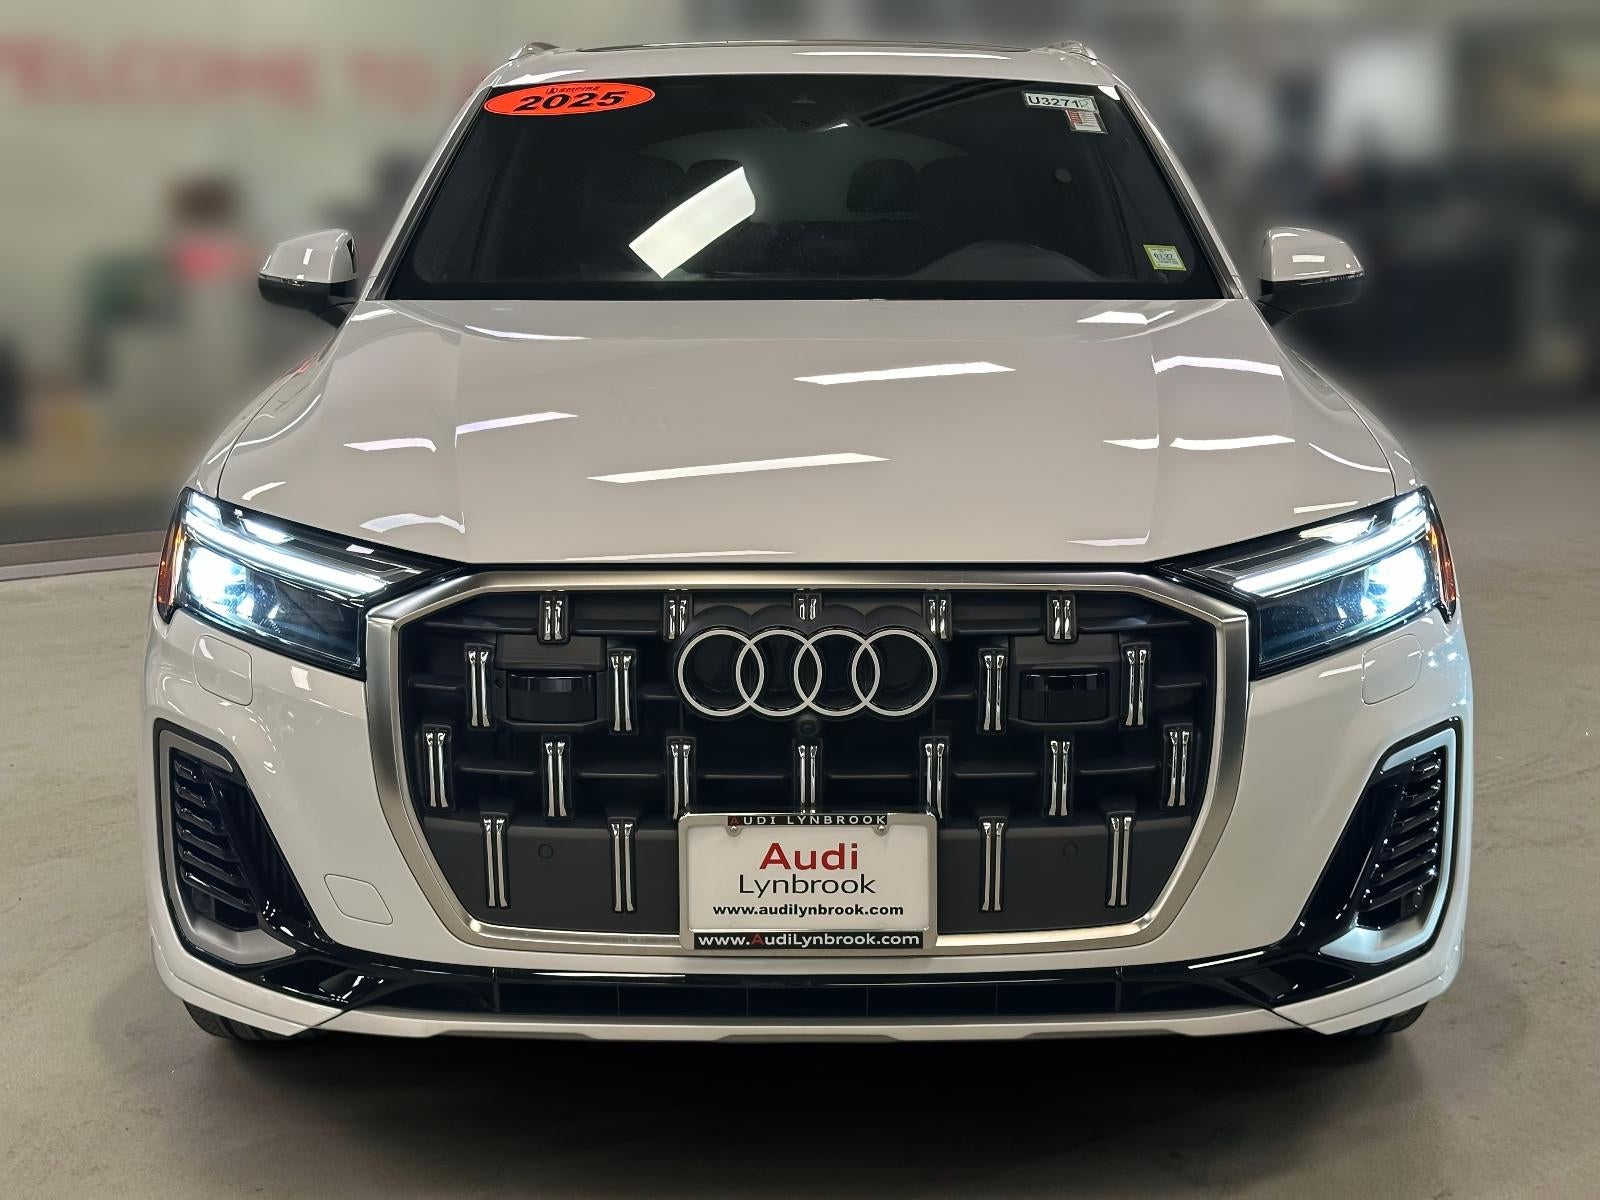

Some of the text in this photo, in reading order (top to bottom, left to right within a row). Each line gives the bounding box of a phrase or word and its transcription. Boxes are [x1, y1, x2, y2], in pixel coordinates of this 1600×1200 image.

[513, 91, 629, 112] 2025
[730, 815, 886, 825] AUDI LYNBROOK
[759, 842, 858, 870] Audi
[739, 873, 876, 898] Lynbrook
[713, 904, 904, 918] www.audilynbrook.com
[698, 932, 920, 947] www.AudiLynbrook.com
